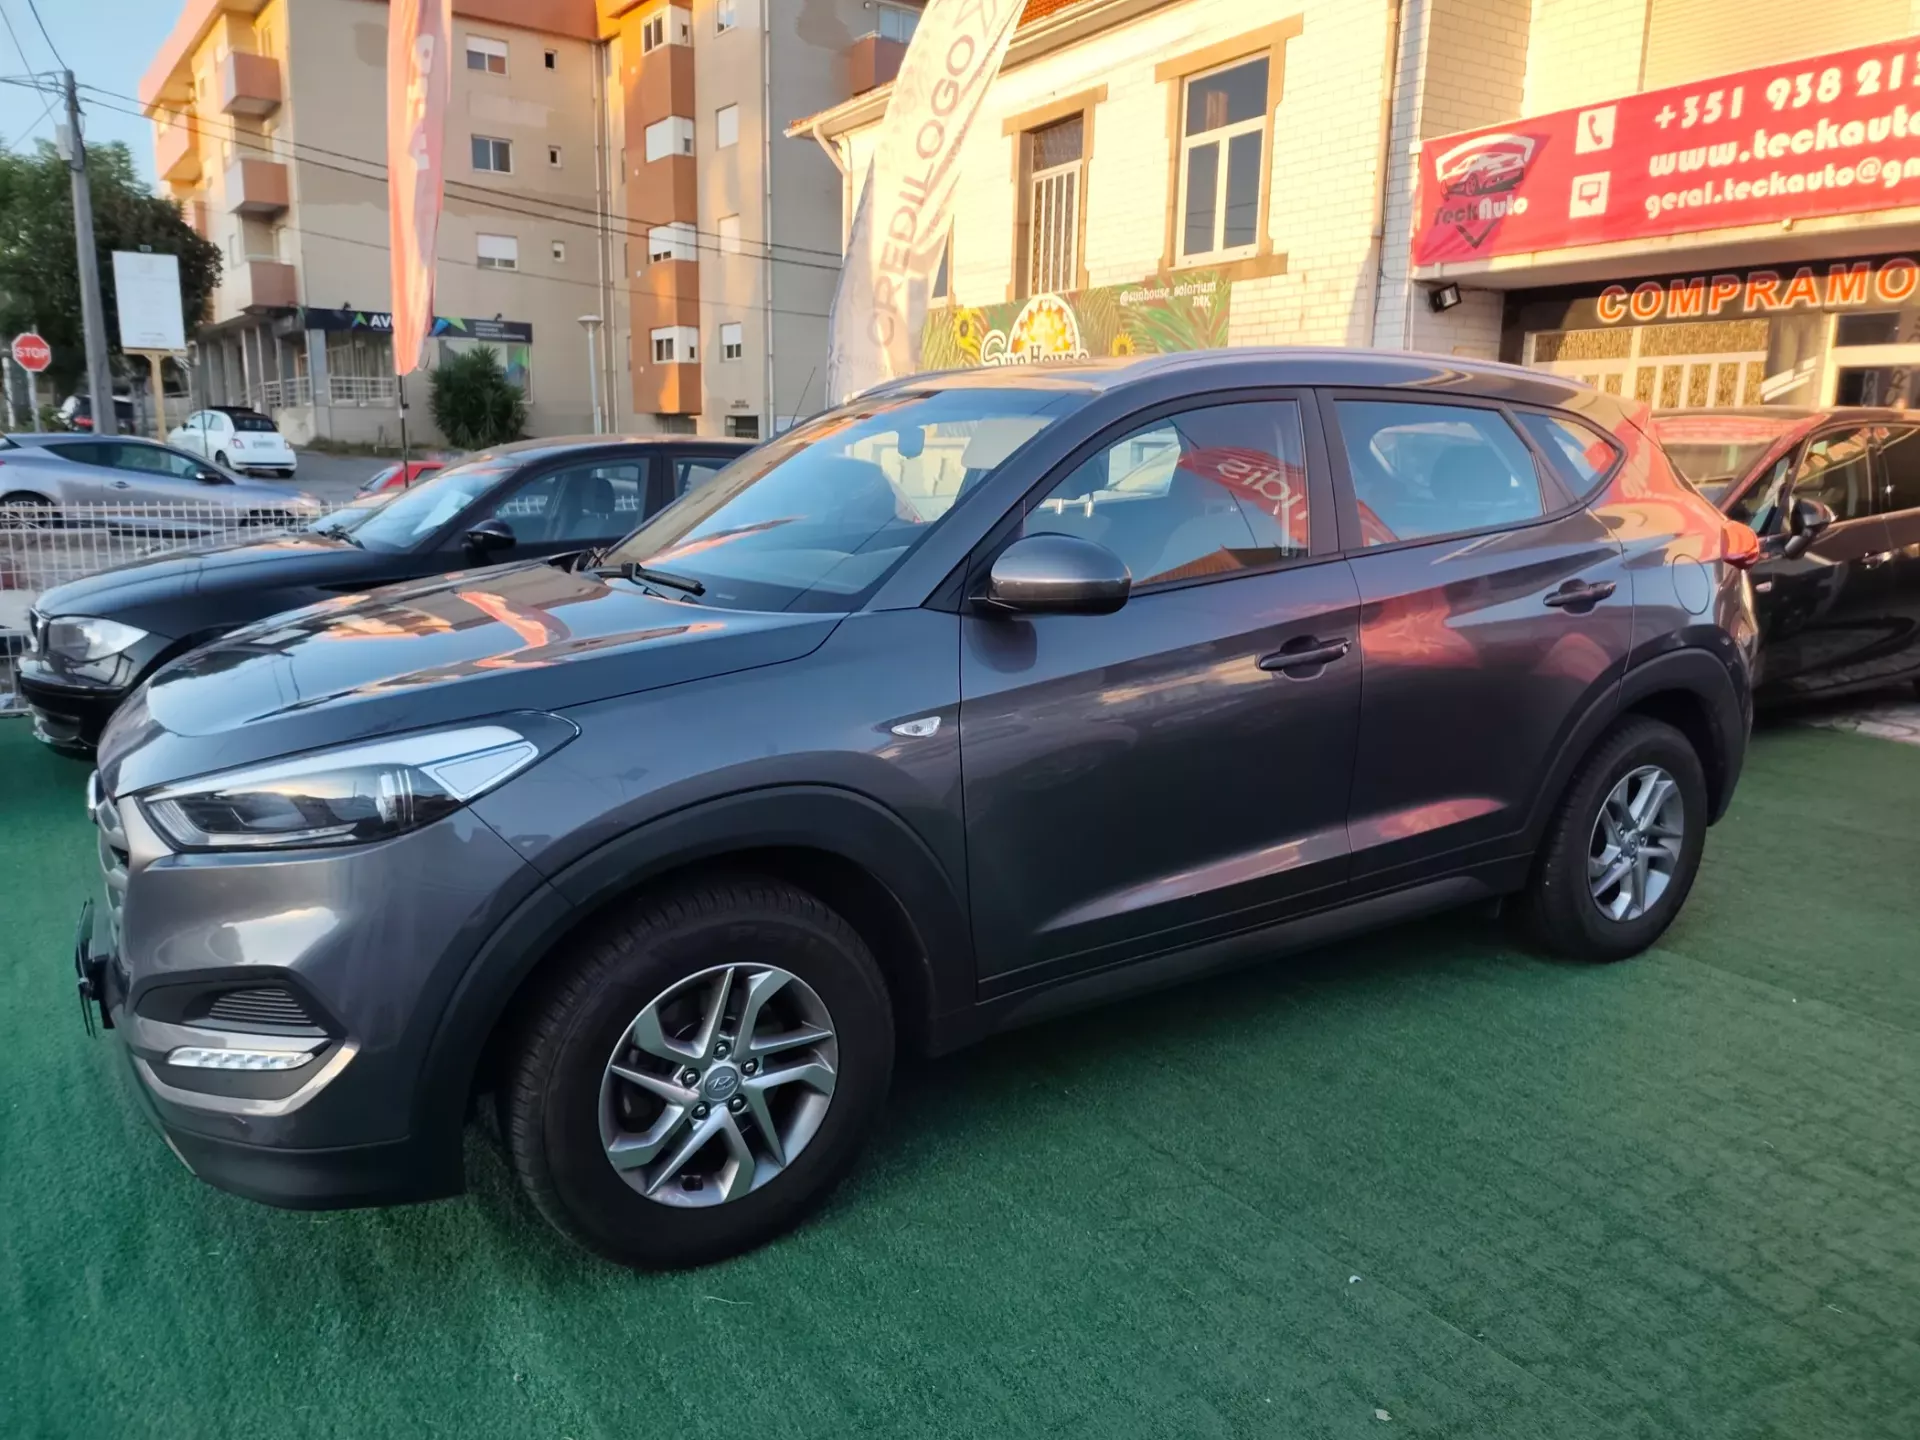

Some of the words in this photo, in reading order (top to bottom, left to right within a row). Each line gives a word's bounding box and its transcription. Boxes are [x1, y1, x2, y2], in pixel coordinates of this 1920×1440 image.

[1653, 86, 1744, 129] +351
[1766, 67, 1842, 111] 938
[867, 34, 976, 348] CREDILOGO
[1597, 258, 1919, 324] COMPRAMO
[15, 346, 50, 359] STOP
